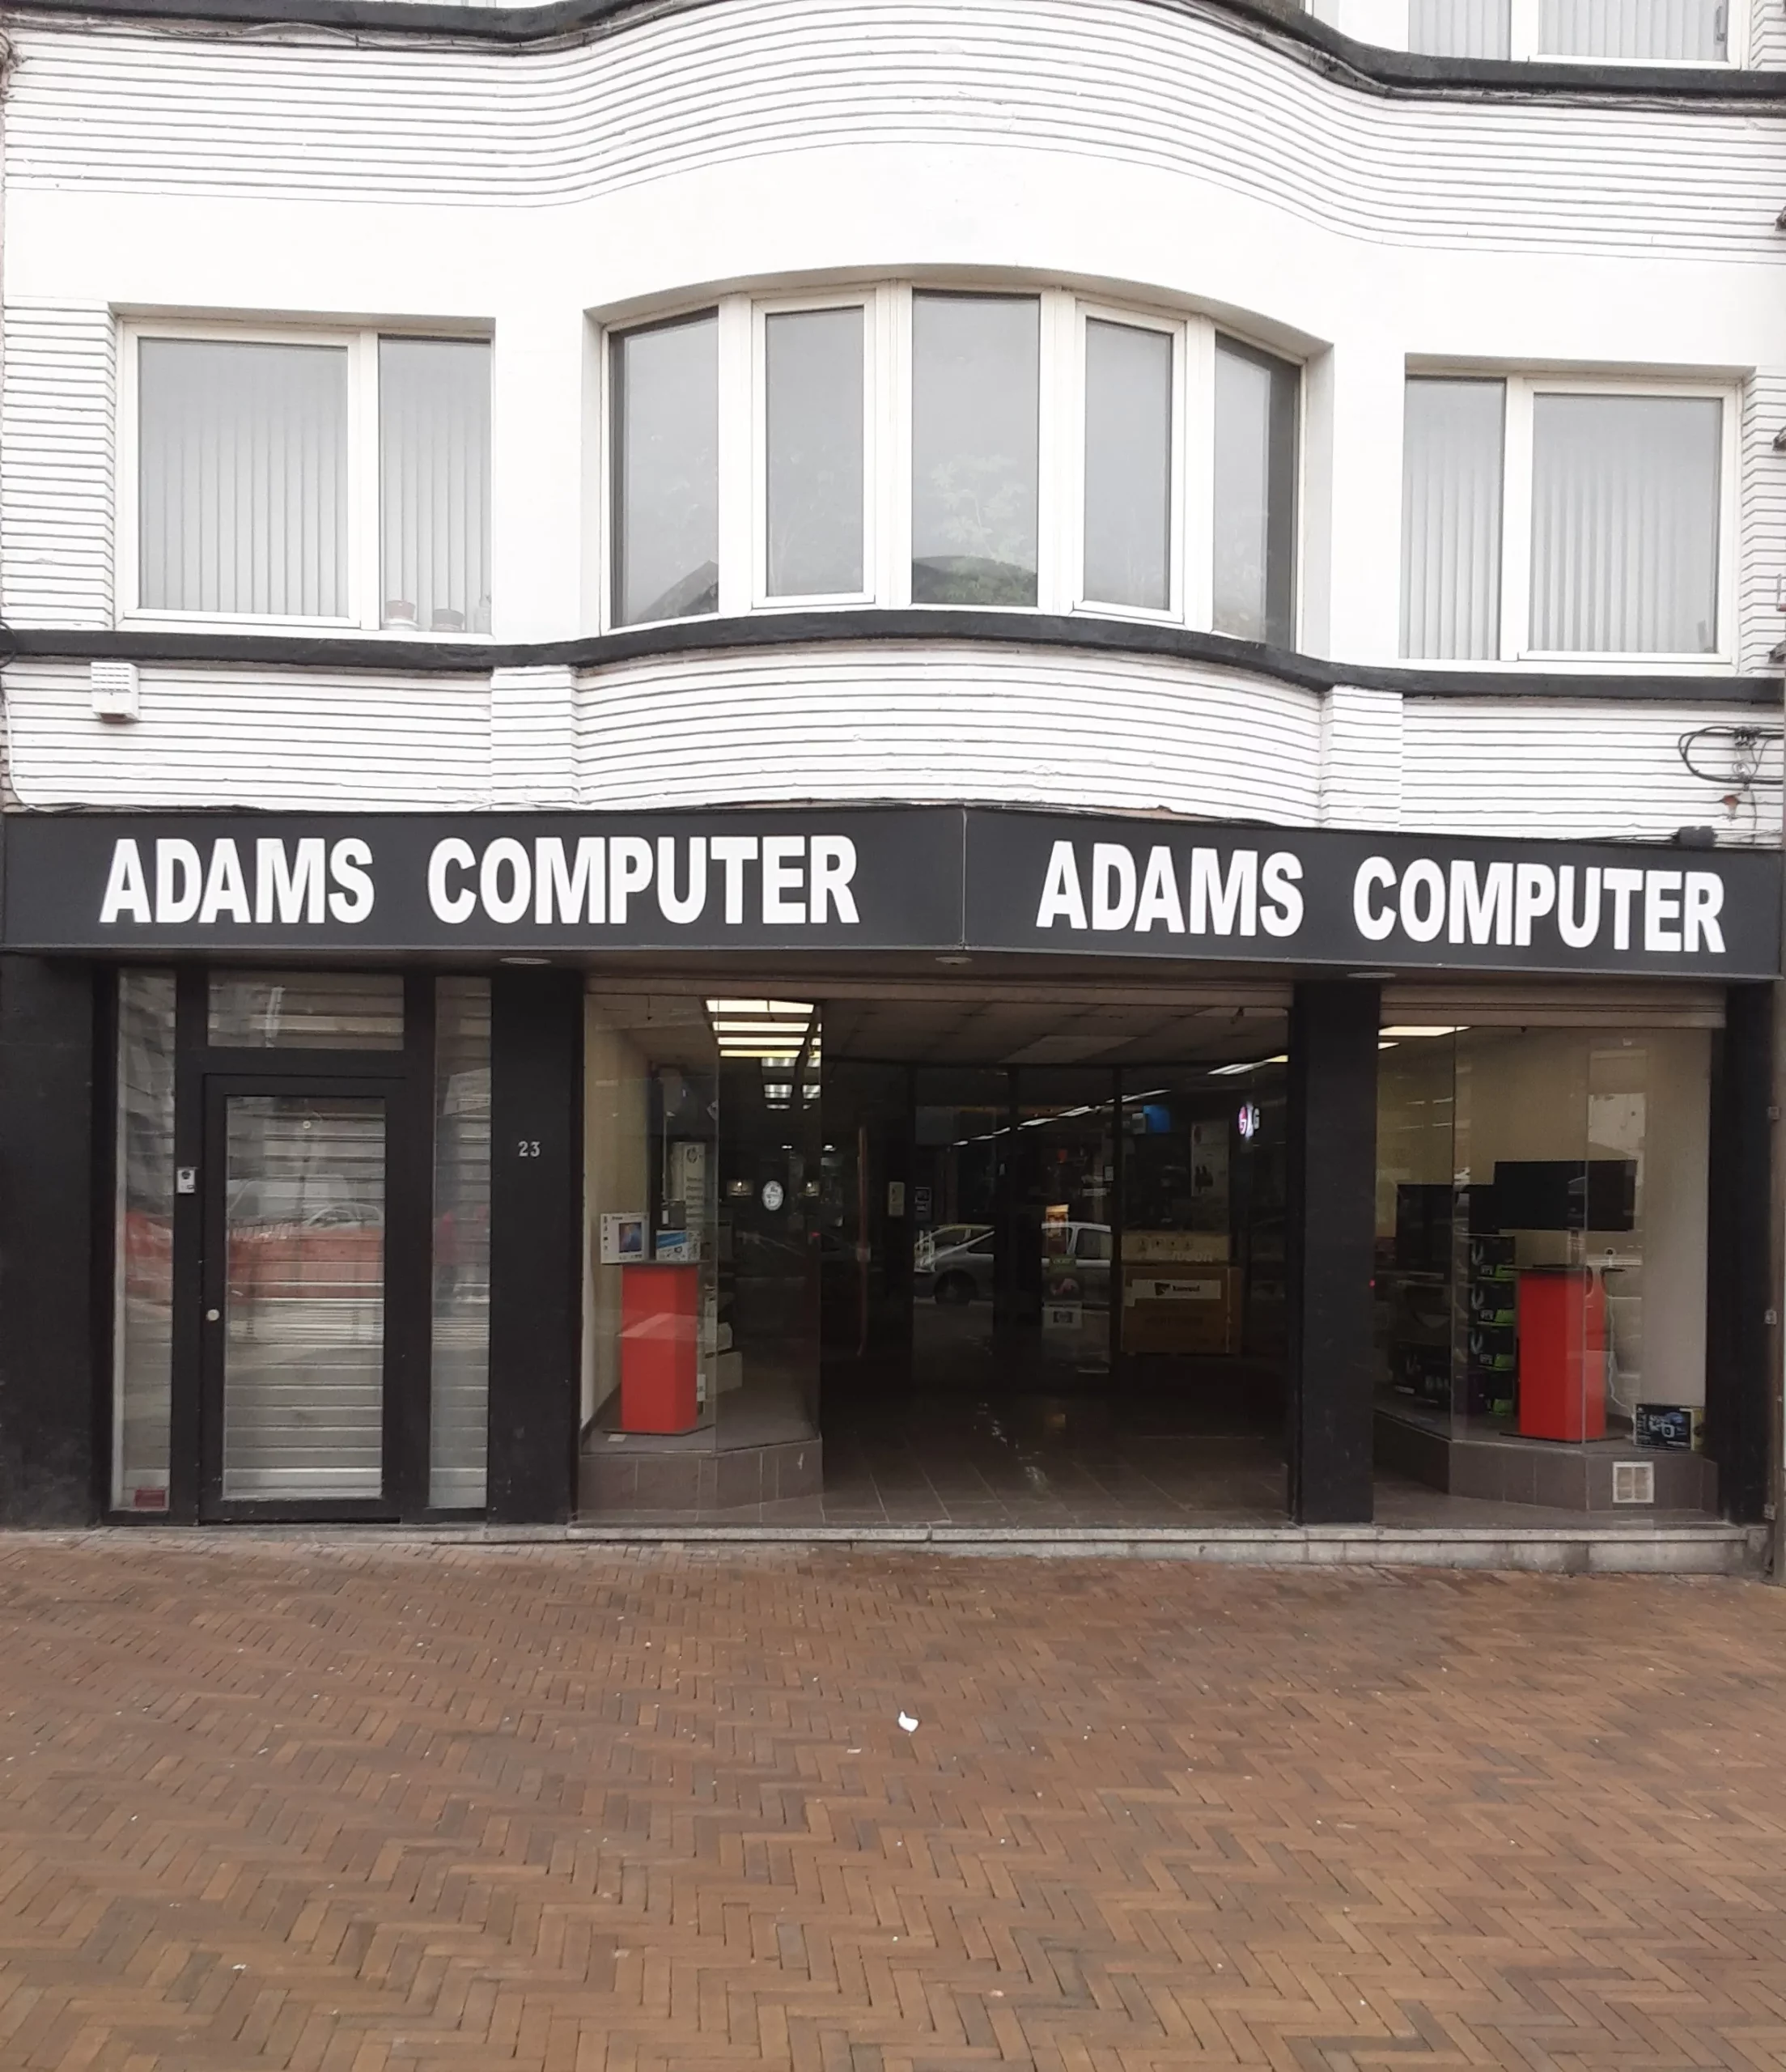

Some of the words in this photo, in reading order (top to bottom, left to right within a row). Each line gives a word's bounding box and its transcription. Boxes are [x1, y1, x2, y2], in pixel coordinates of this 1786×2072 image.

[99, 837, 375, 924] ADAMS
[426, 834, 860, 925] COMPUTER
[1035, 839, 1305, 937] ADAMS
[1353, 855, 1727, 953] COMPUTER
[518, 1140, 541, 1157] 23
